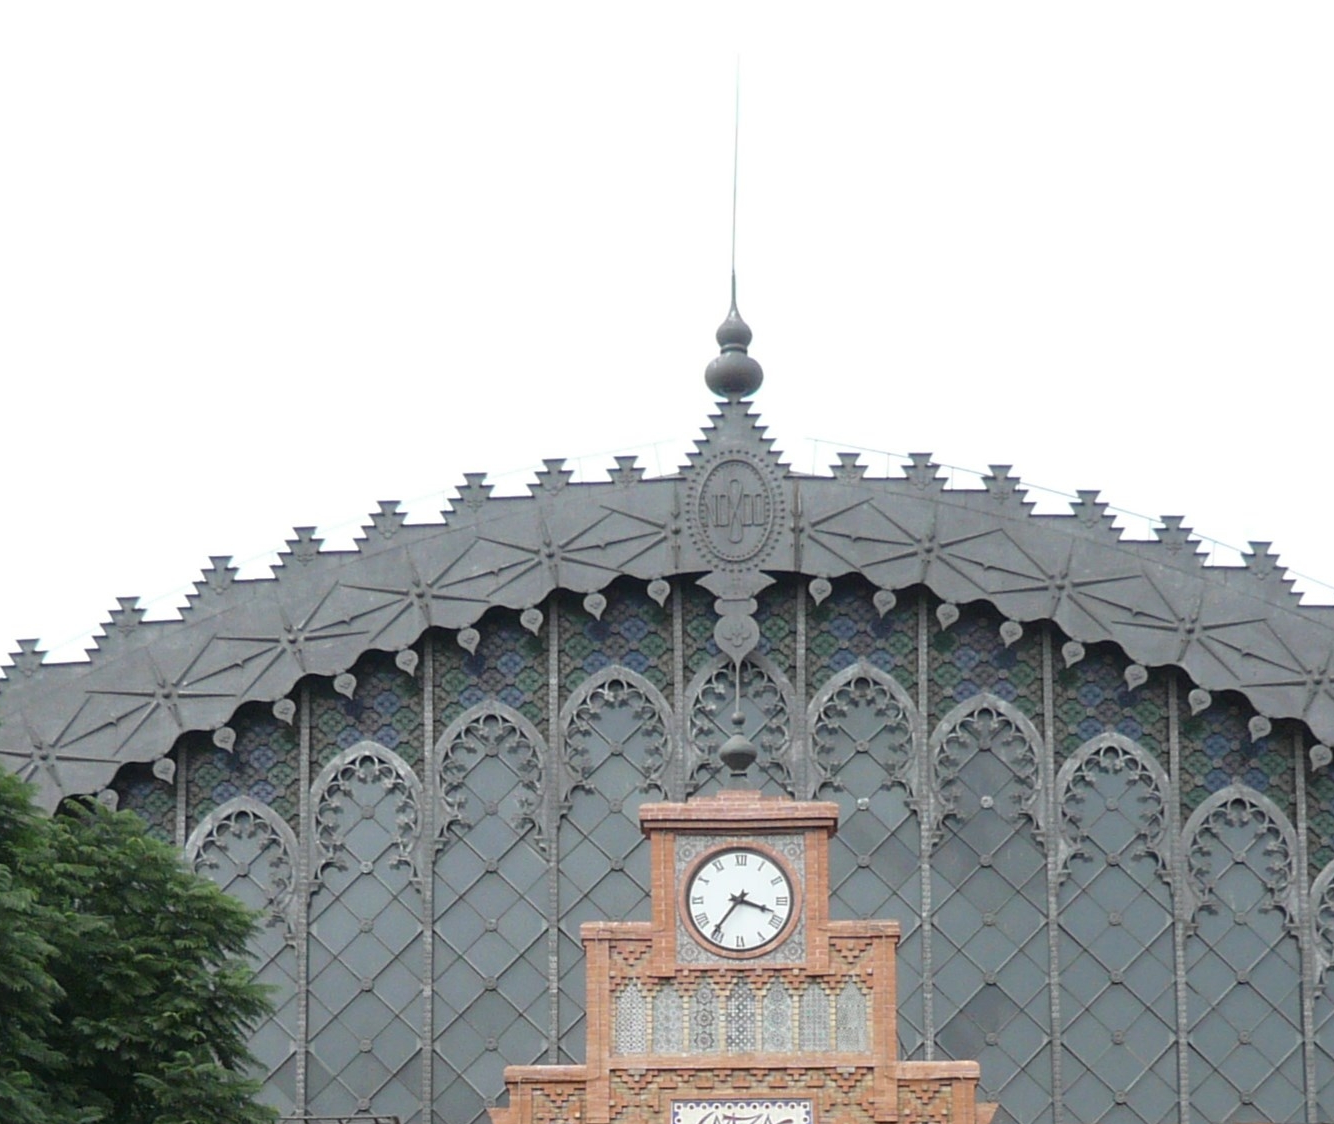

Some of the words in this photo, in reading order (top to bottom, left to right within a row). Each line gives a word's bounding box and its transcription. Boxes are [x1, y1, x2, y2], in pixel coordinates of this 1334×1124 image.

[735, 854, 747, 866] XII
[770, 875, 783, 886] II
[775, 896, 788, 906] III
